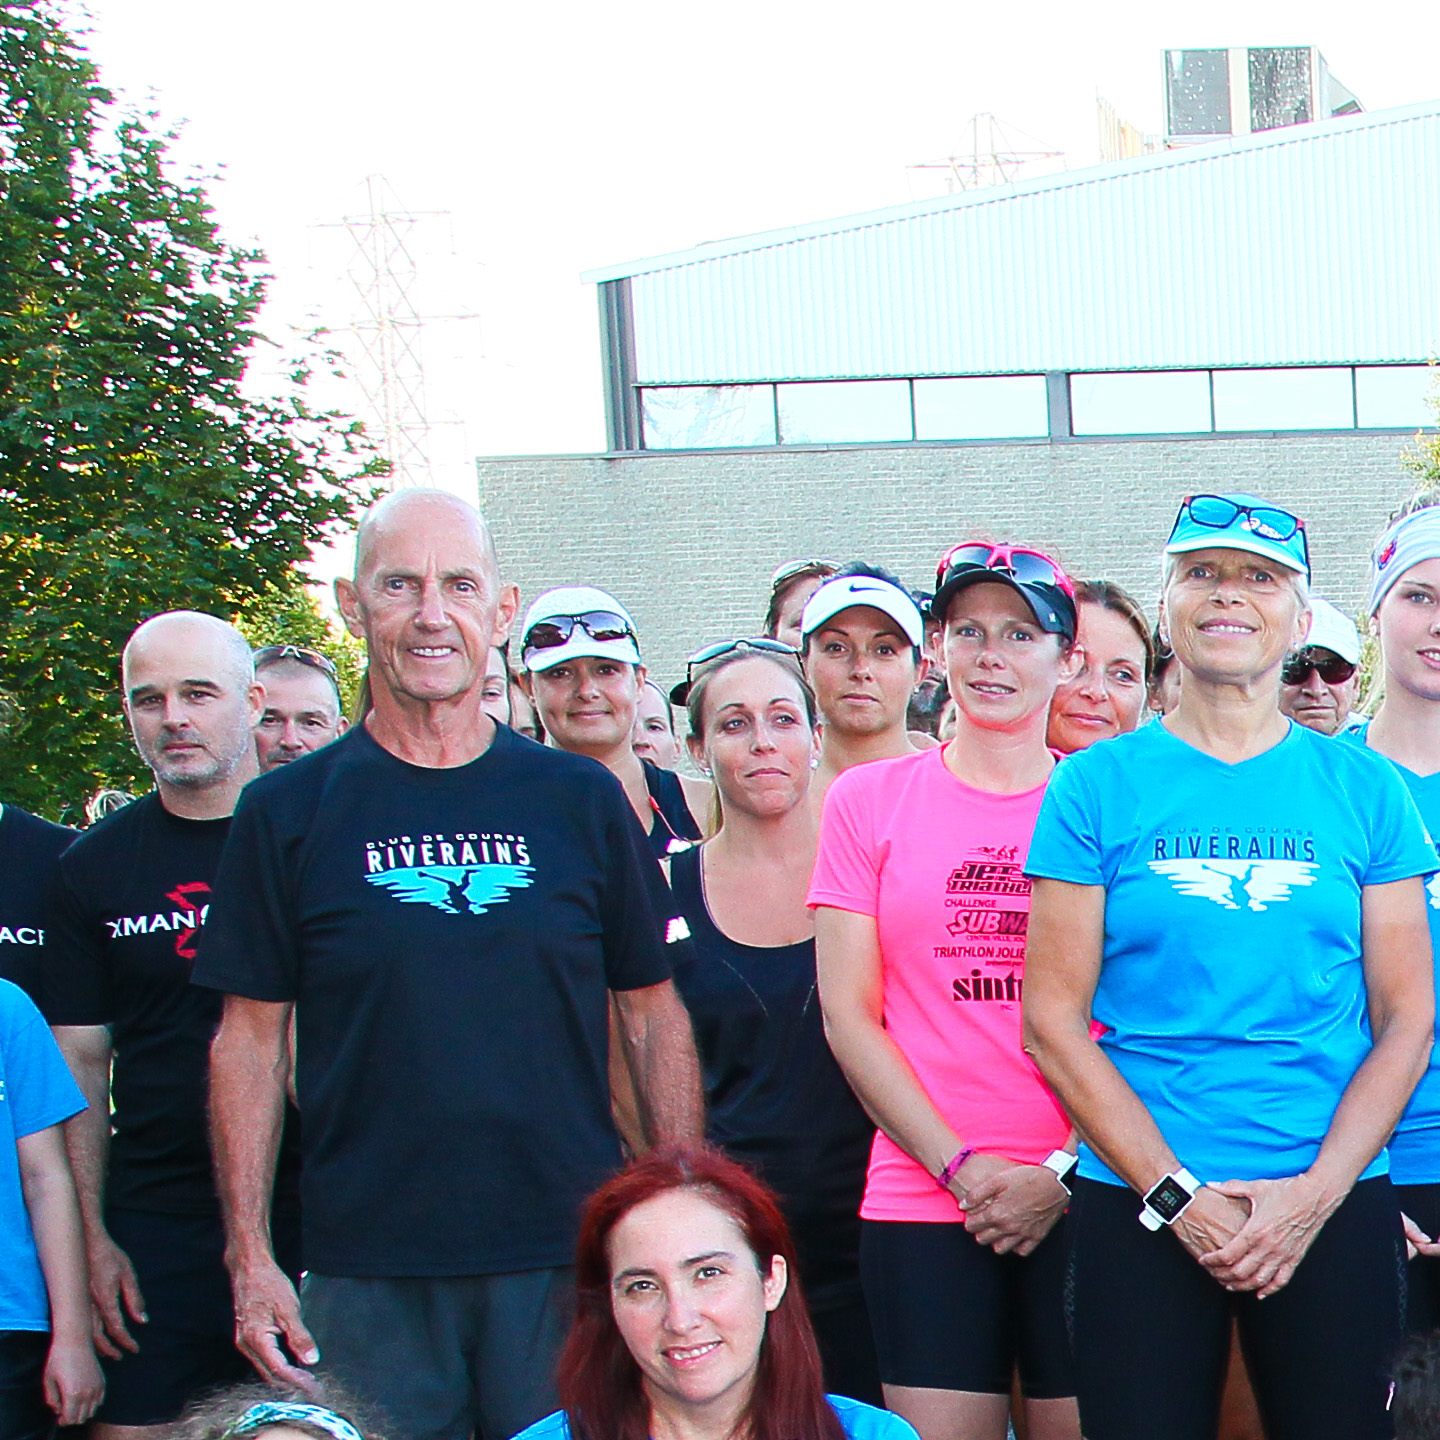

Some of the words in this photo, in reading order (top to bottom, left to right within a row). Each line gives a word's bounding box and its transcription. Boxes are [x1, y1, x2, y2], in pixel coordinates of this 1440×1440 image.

[367, 841, 530, 873] RIVERAINS
[1155, 836, 1315, 862] RIVERAINS
[944, 899, 997, 908] CHALLENGE
[933, 946, 995, 958] TRIATHLON
